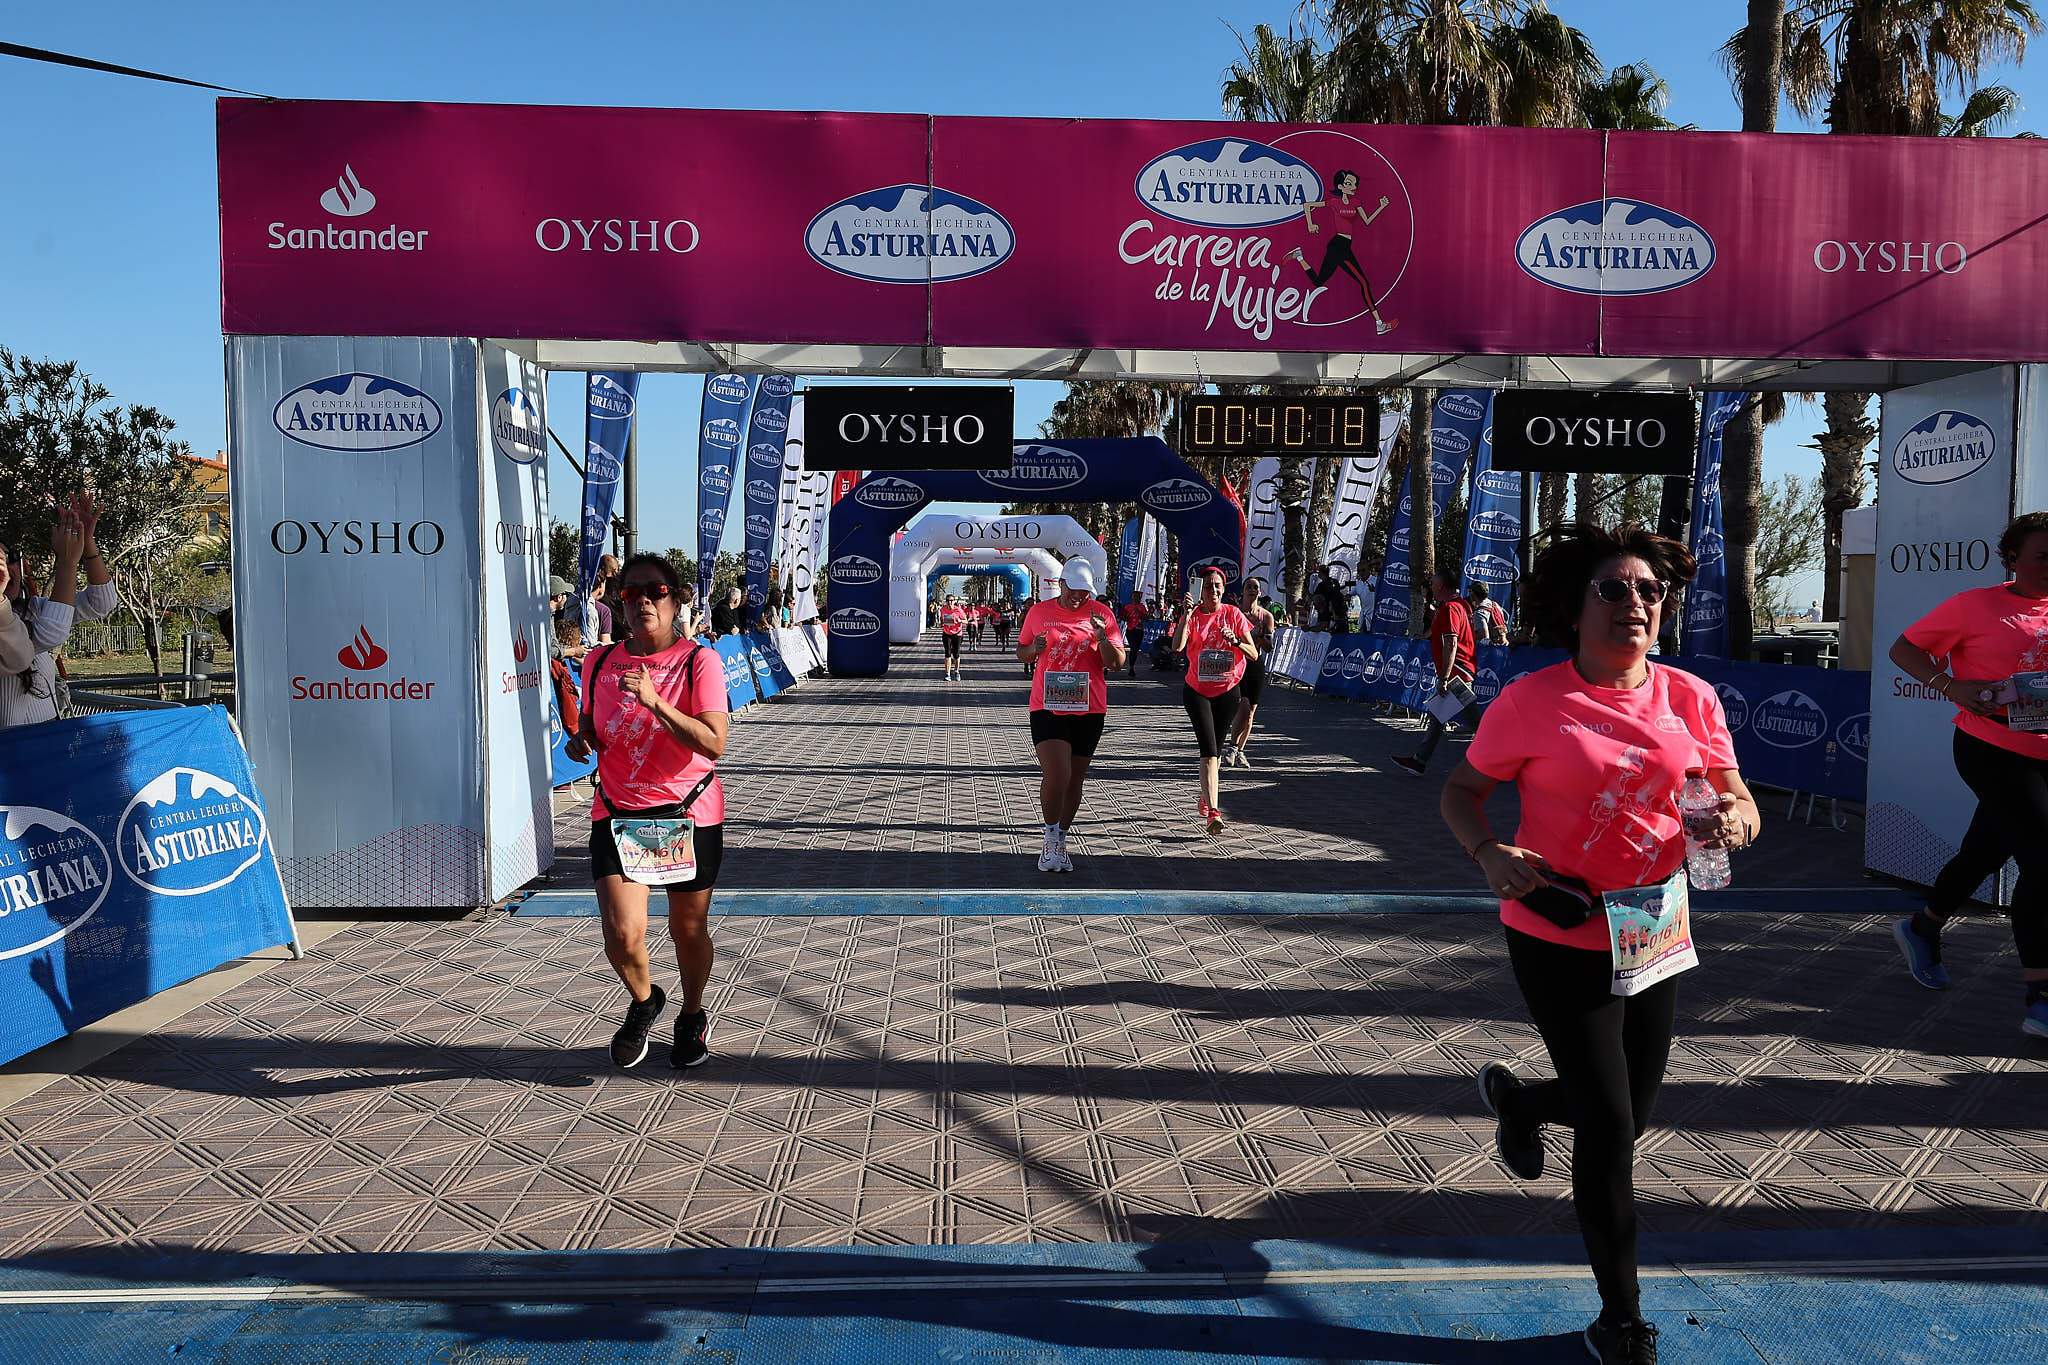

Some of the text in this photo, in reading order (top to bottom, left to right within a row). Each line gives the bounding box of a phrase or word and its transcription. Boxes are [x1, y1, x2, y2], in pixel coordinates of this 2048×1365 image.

[1150, 169, 1308, 206] ASTURIANA
[1179, 168, 1303, 179] CENTRAL LECHERA
[267, 222, 428, 251] Santander
[535, 218, 699, 253] OYSHO
[853, 218, 919, 228] CENTRAL
[1561, 231, 1695, 243] CENTRAL LECHERA
[821, 220, 999, 258] ASTURIANA
[1118, 219, 1272, 269] Carrera
[1531, 231, 1700, 272] ASTURIANA
[1814, 239, 1967, 274] OYSHO
[1155, 265, 1328, 341] de la Mujer
[286, 402, 430, 433] ASTURIANA
[311, 400, 424, 410] CENTRAL LECHERA
[591, 394, 628, 414] URIANA
[497, 418, 541, 449] ASTURIANA
[838, 412, 985, 445] OYSHO
[1195, 405, 1364, 446] 00:40:18
[1525, 415, 1666, 450] OYSHO
[1914, 430, 1984, 448] CENTRAL LECHERA
[1432, 435, 1466, 450] STURIANA
[1899, 441, 1986, 470] ASTURIANA
[859, 488, 919, 502] ASTURIANA
[1147, 490, 1208, 503] ASTURIANA
[1479, 475, 1521, 491] ASTURIA
[270, 519, 445, 556] OYSHO
[496, 520, 543, 557] OYSHO
[903, 540, 930, 548] OYSHO
[955, 521, 1042, 540] OYSHO
[1065, 540, 1091, 548] OYSHO
[1891, 539, 1989, 574] OYSHO
[831, 566, 878, 578] ASTURIANA
[891, 575, 916, 583] OYSHO
[831, 617, 877, 630] ASTURIANA
[292, 676, 435, 701] Santander
[502, 669, 542, 694] Santander
[1756, 708, 1817, 737] ASTURIANA
[150, 801, 245, 830] CENTRAL LECHERA
[20, 838, 84, 862] LECHERA
[135, 817, 258, 875] ASTURIANA
[0, 854, 103, 918] URIANA
